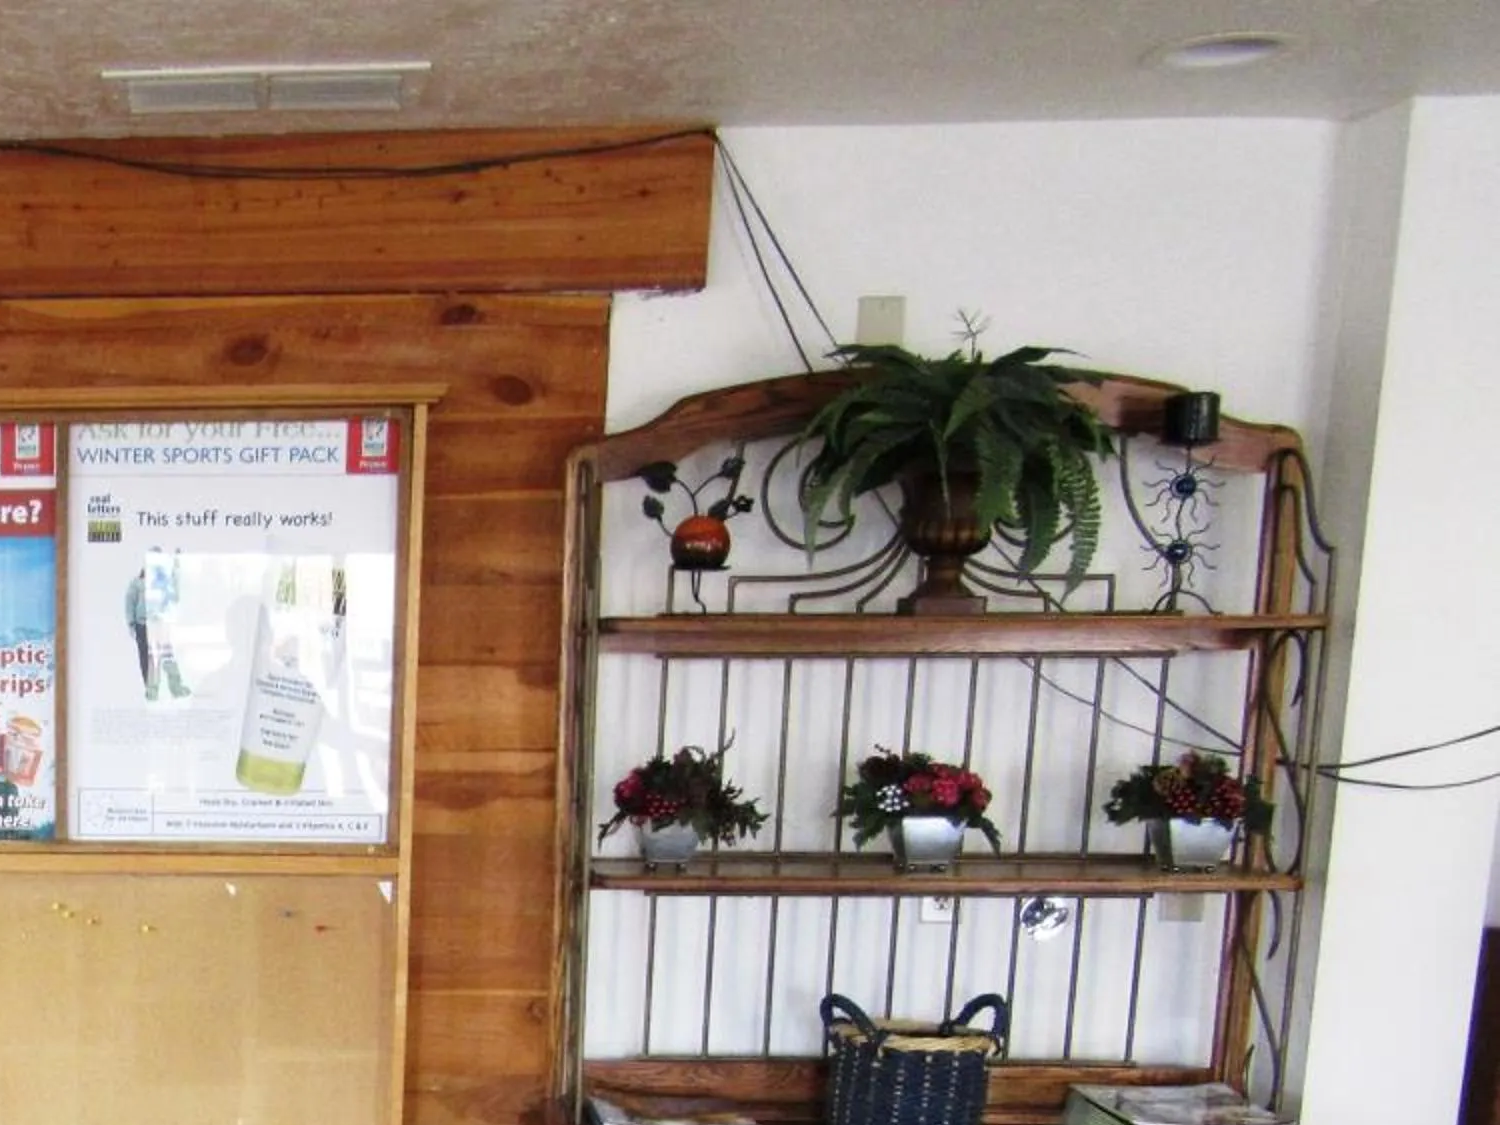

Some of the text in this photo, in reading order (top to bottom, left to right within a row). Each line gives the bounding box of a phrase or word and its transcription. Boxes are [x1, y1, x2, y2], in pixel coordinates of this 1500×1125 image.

[77, 446, 339, 464] WINTER SPORTS GIFT PACK
[136, 509, 333, 529] This stuff really works!
